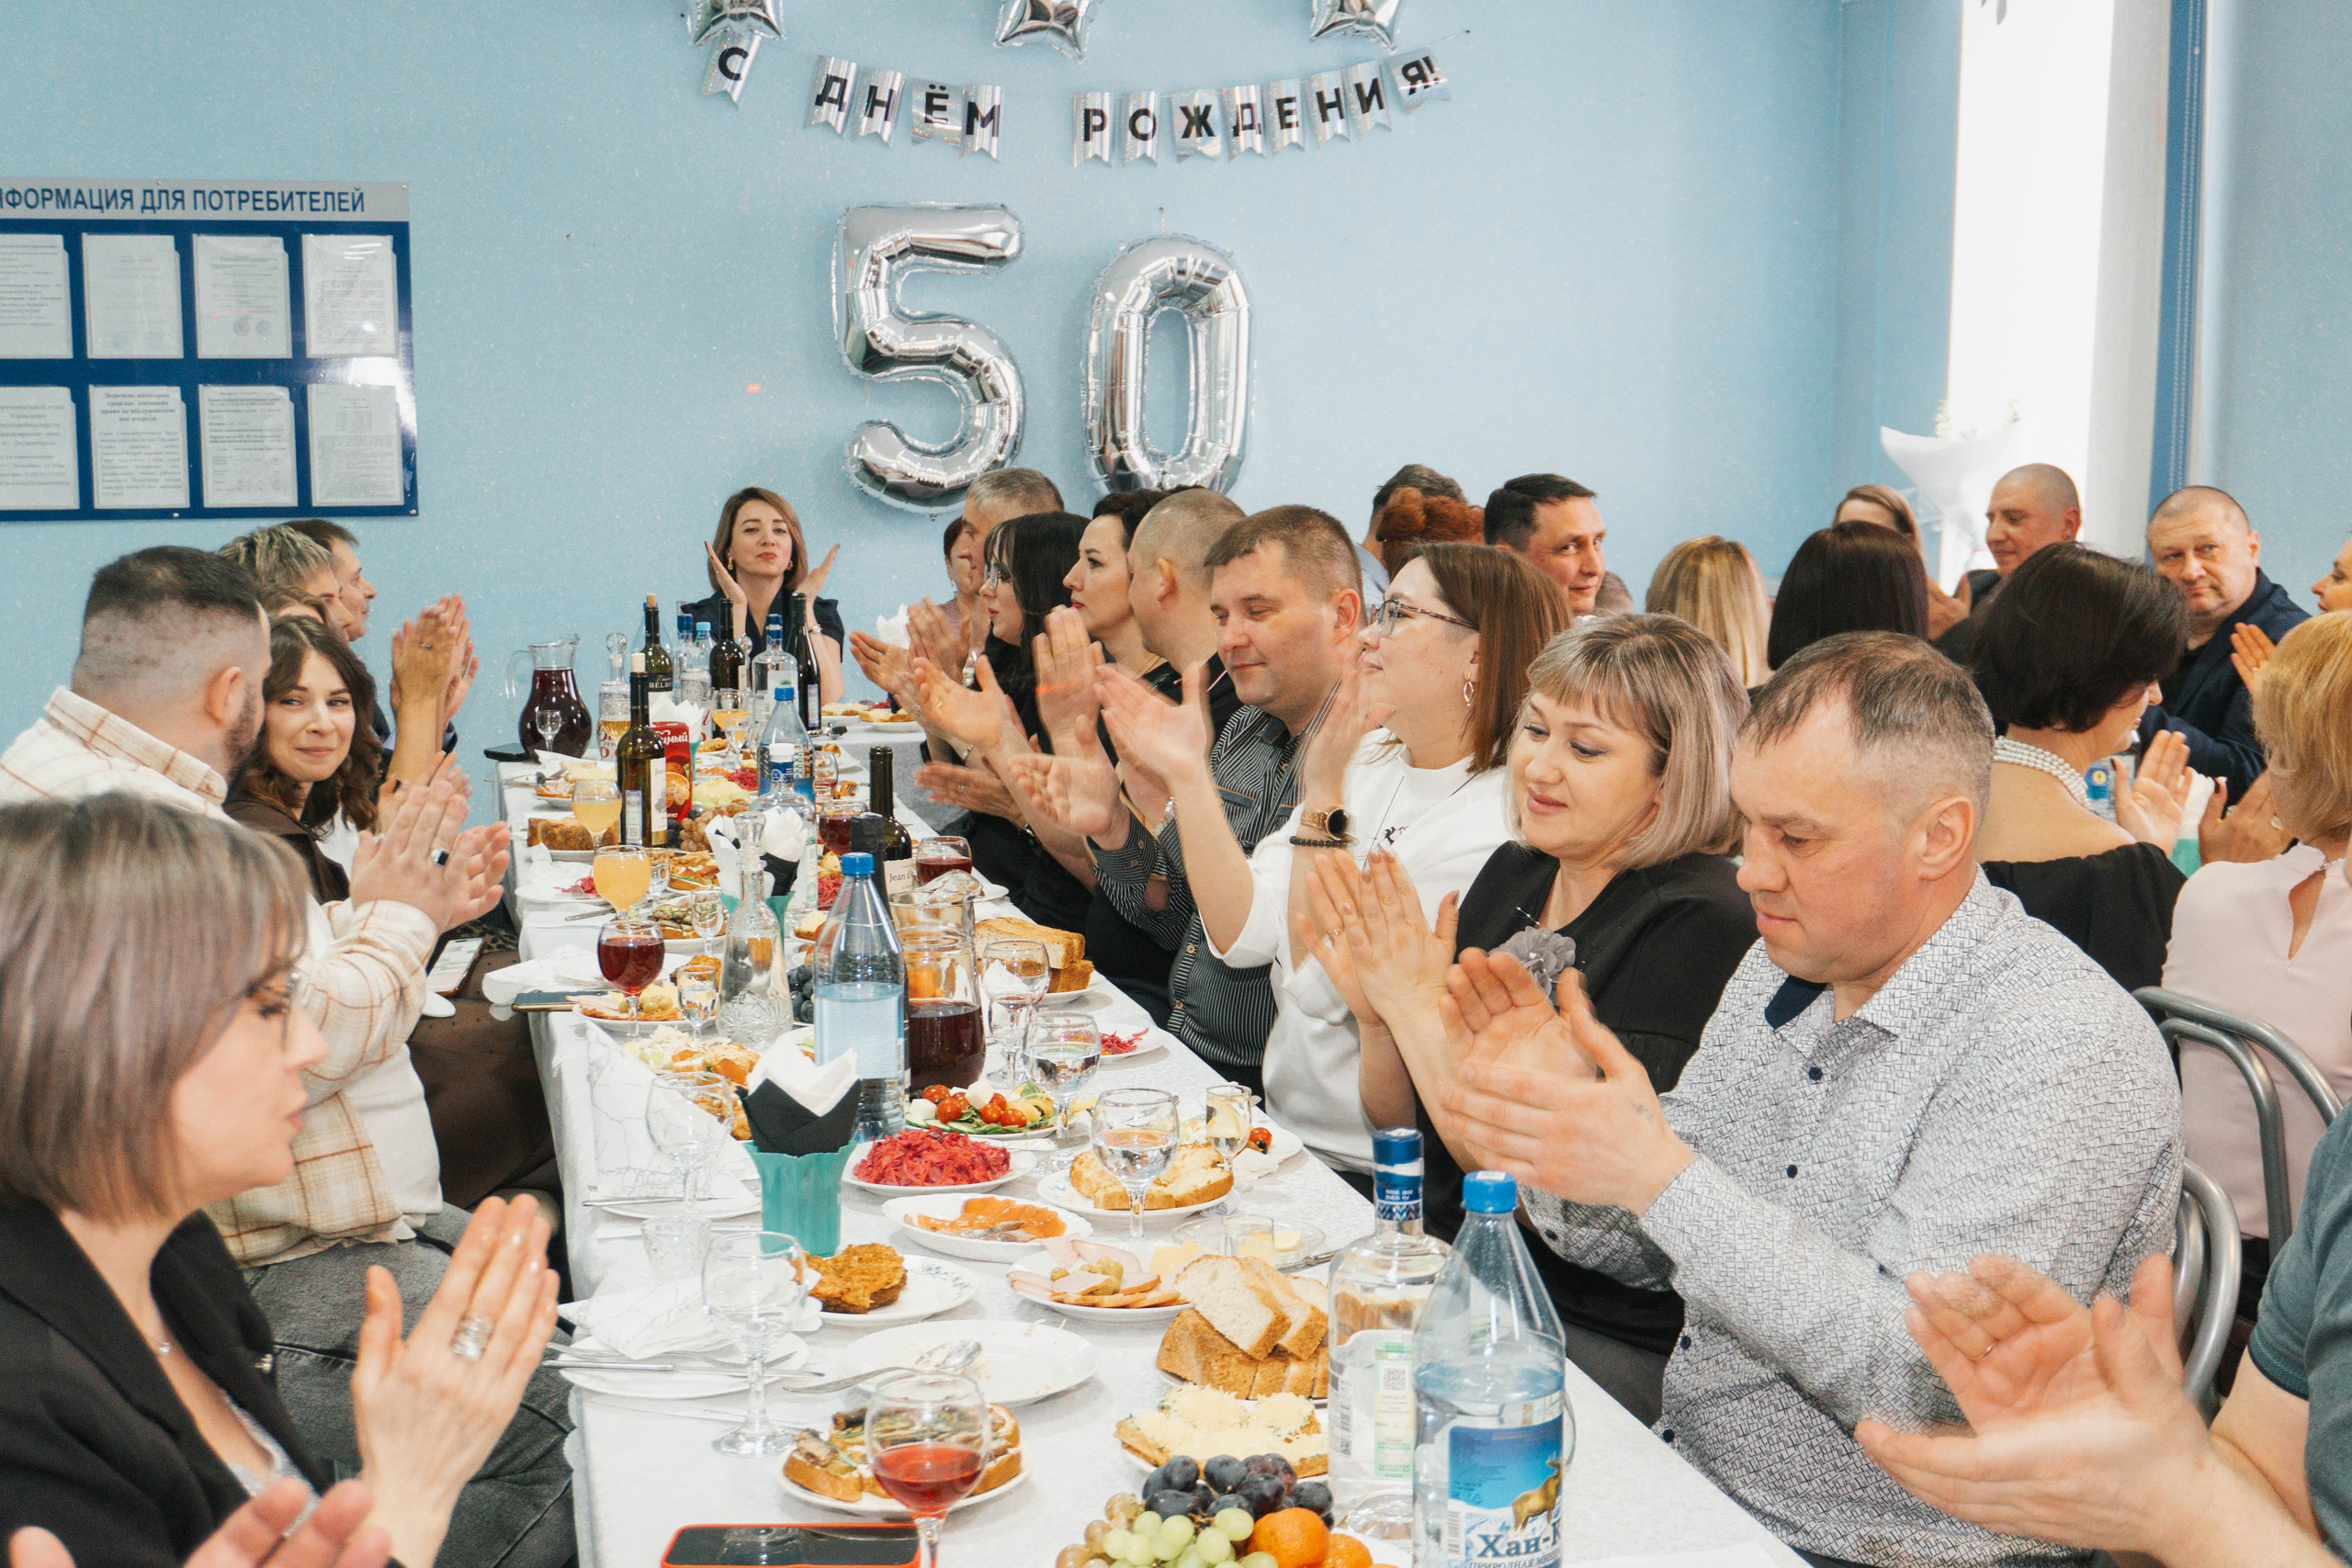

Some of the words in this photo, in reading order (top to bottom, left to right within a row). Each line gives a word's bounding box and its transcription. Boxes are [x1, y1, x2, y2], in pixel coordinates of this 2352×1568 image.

[718, 47, 749, 81] С
[815, 73, 1001, 138] ДНЁМ
[1083, 55, 1441, 142] РОЖДЕНИЯ!
[141, 189, 185, 214] ДЛЯ
[193, 186, 365, 212] ПОТРЕБИТЕЛЕЙ
[831, 201, 1257, 514] 50
